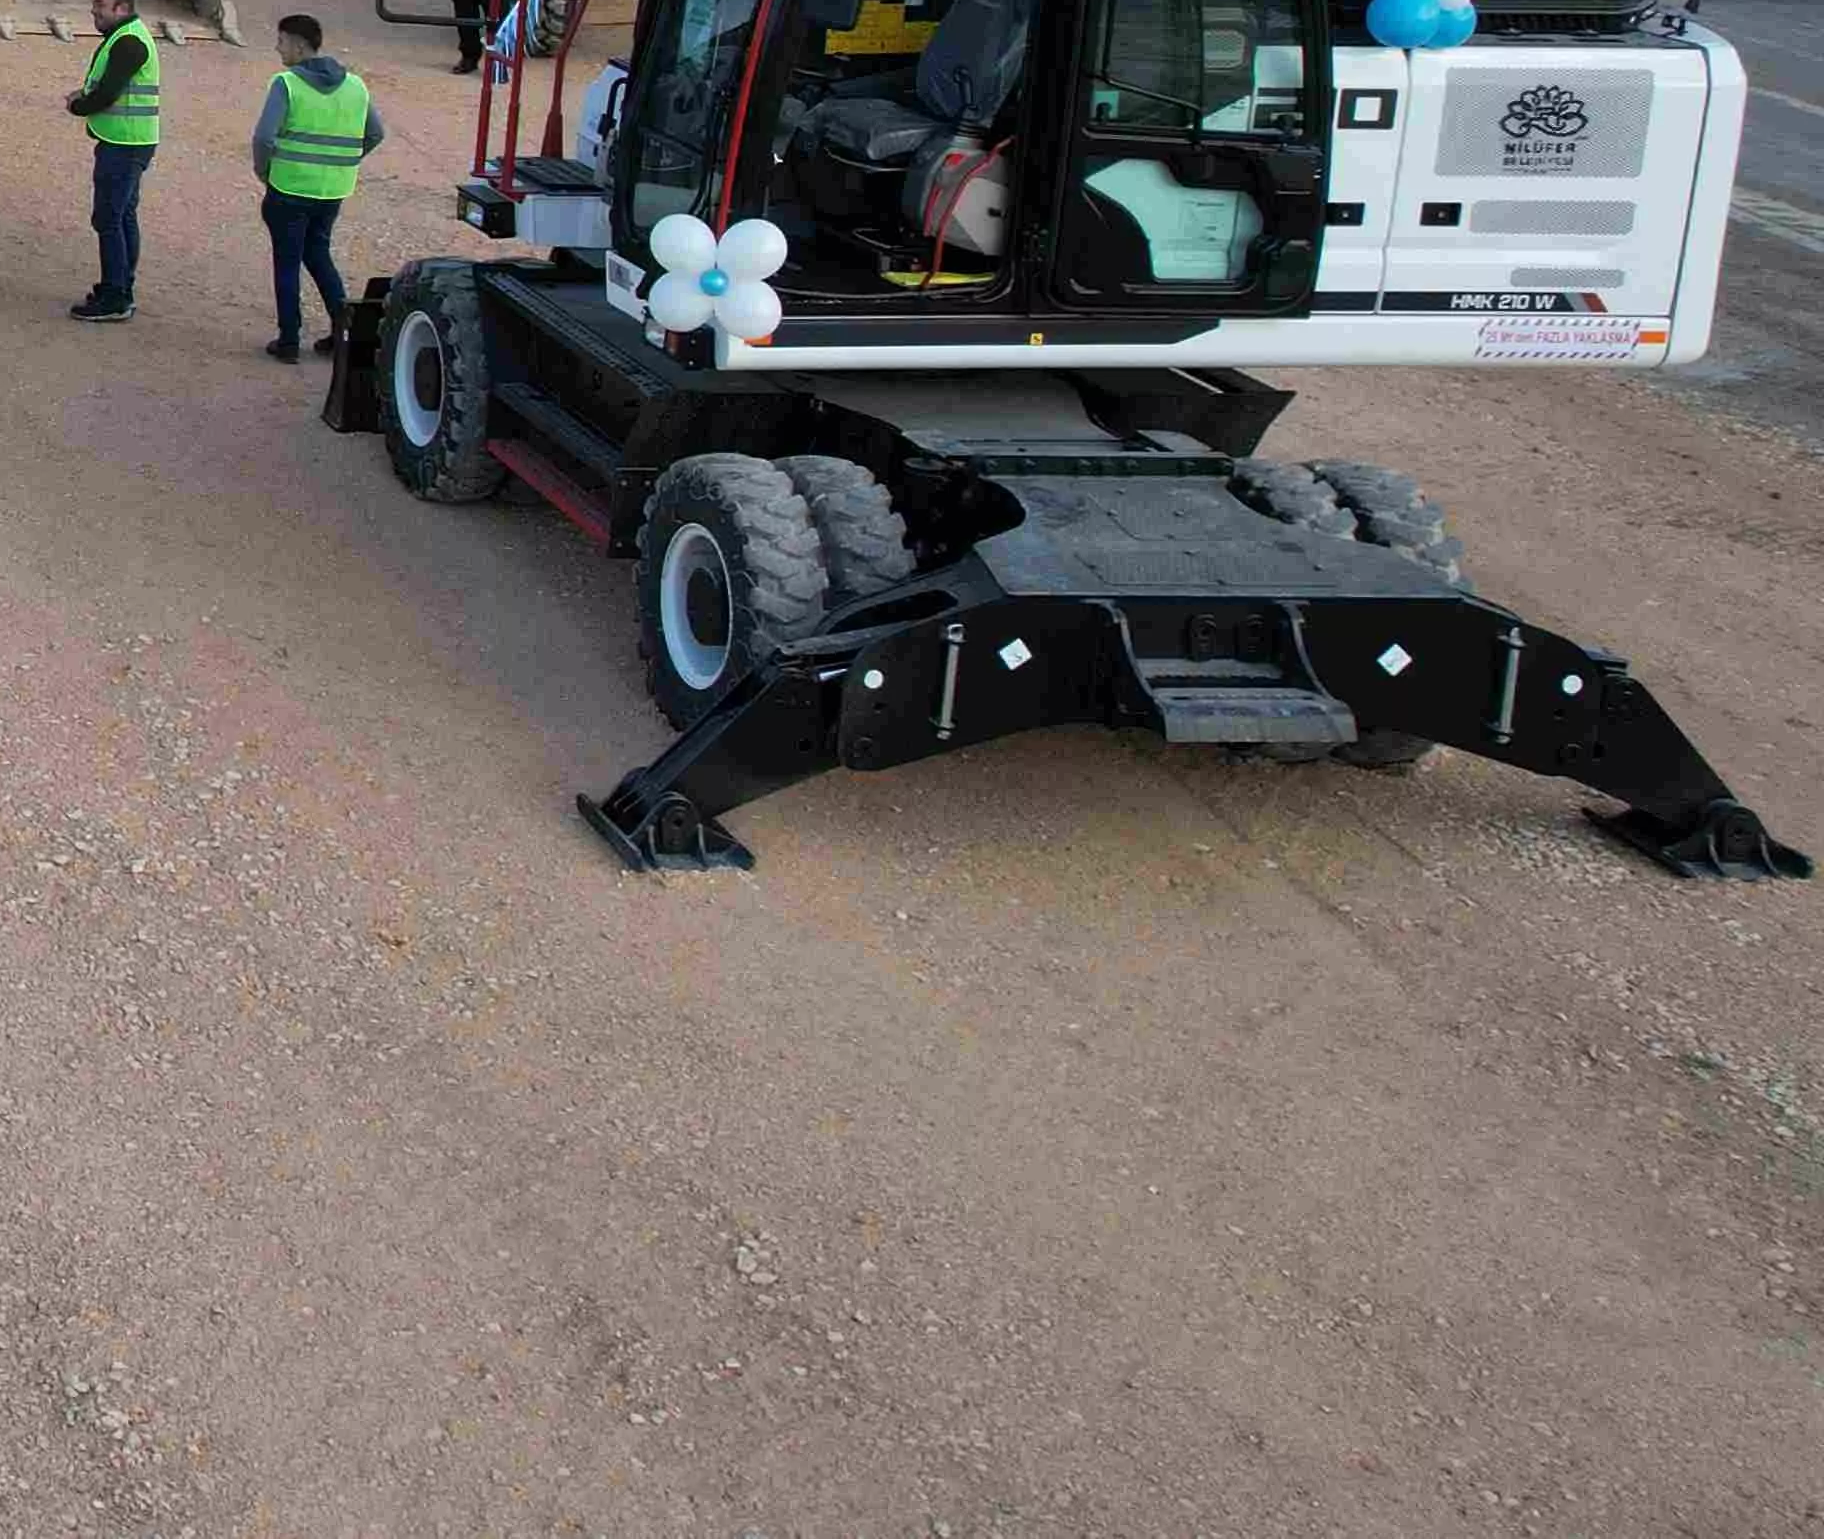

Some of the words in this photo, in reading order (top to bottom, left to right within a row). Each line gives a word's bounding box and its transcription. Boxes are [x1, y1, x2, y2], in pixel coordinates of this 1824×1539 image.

[1504, 140, 1576, 154] NİLÜFER
[1451, 295, 1493, 310] HMK
[1498, 295, 1530, 309] 210
[1534, 295, 1557, 310] W
[1536, 331, 1570, 343] FAZLA
